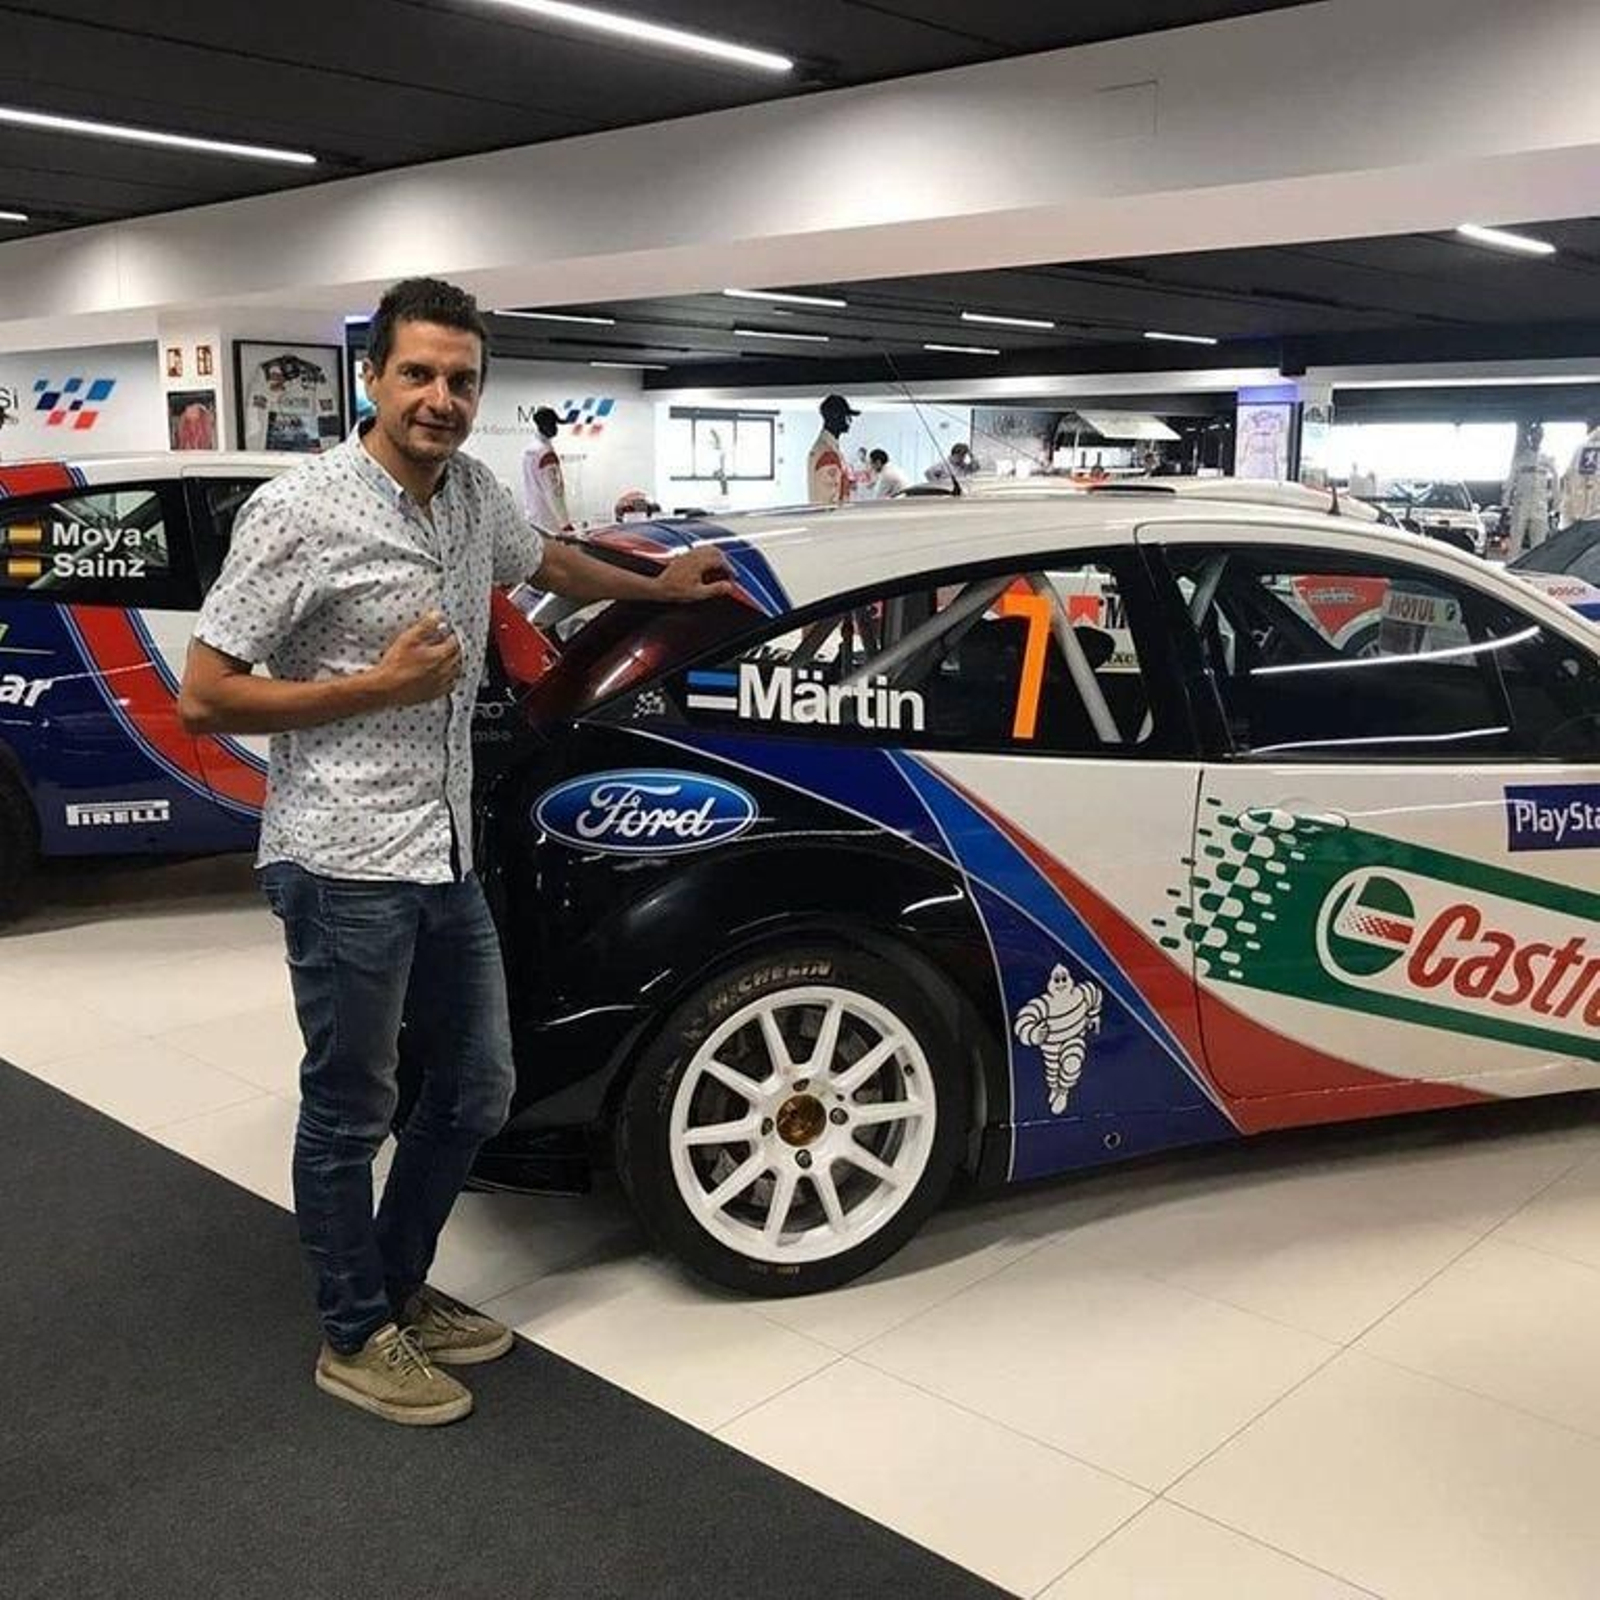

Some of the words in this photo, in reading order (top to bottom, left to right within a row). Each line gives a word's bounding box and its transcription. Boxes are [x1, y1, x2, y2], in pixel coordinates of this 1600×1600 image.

[52, 522, 142, 551] Moya
[53, 553, 146, 578] Sainz
[738, 663, 925, 732] Märtin
[66, 800, 170, 825] PIRELLI
[575, 781, 717, 839] Ford
